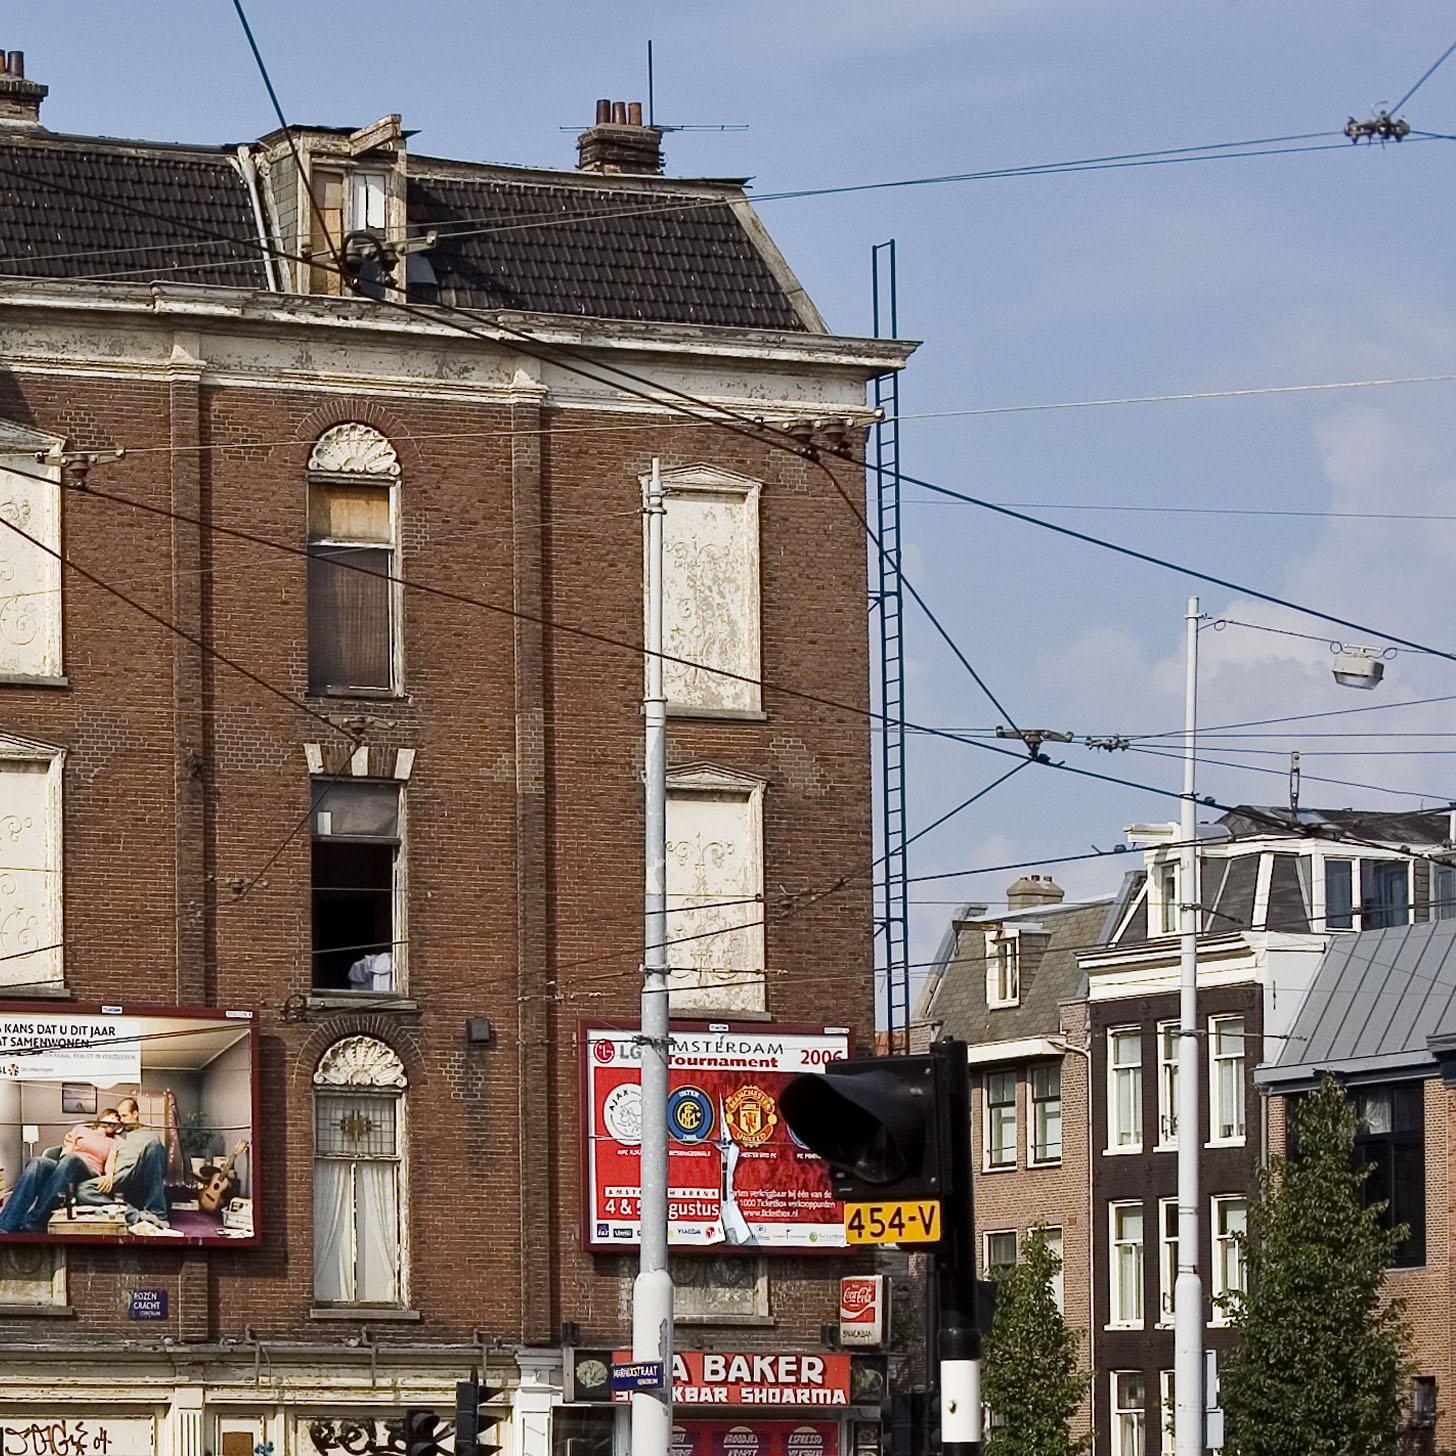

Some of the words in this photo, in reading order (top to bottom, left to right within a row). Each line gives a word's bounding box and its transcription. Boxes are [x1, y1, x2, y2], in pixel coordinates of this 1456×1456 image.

[4, 1023, 34, 1035] KANS
[37, 1024, 57, 1035] DAT
[59, 1025, 68, 1036] U
[70, 1025, 88, 1036] DIT
[90, 1026, 116, 1039] JAAR
[619, 1044, 641, 1060] LG
[672, 1040, 784, 1055] MSTERDAM
[800, 1049, 843, 1066] 2006
[667, 1054, 779, 1068] Tournament
[608, 1089, 629, 1112] AJAX
[605, 1198, 616, 1214] 4
[619, 1198, 633, 1215] &
[668, 1199, 720, 1220] gustus
[847, 1204, 936, 1239] 454-V
[133, 1291, 157, 1300] ROZEN
[704, 1355, 825, 1384] BAKER
[741, 1388, 847, 1405] SHOARMA
[787, 1434, 823, 1444] ESPRESSO
